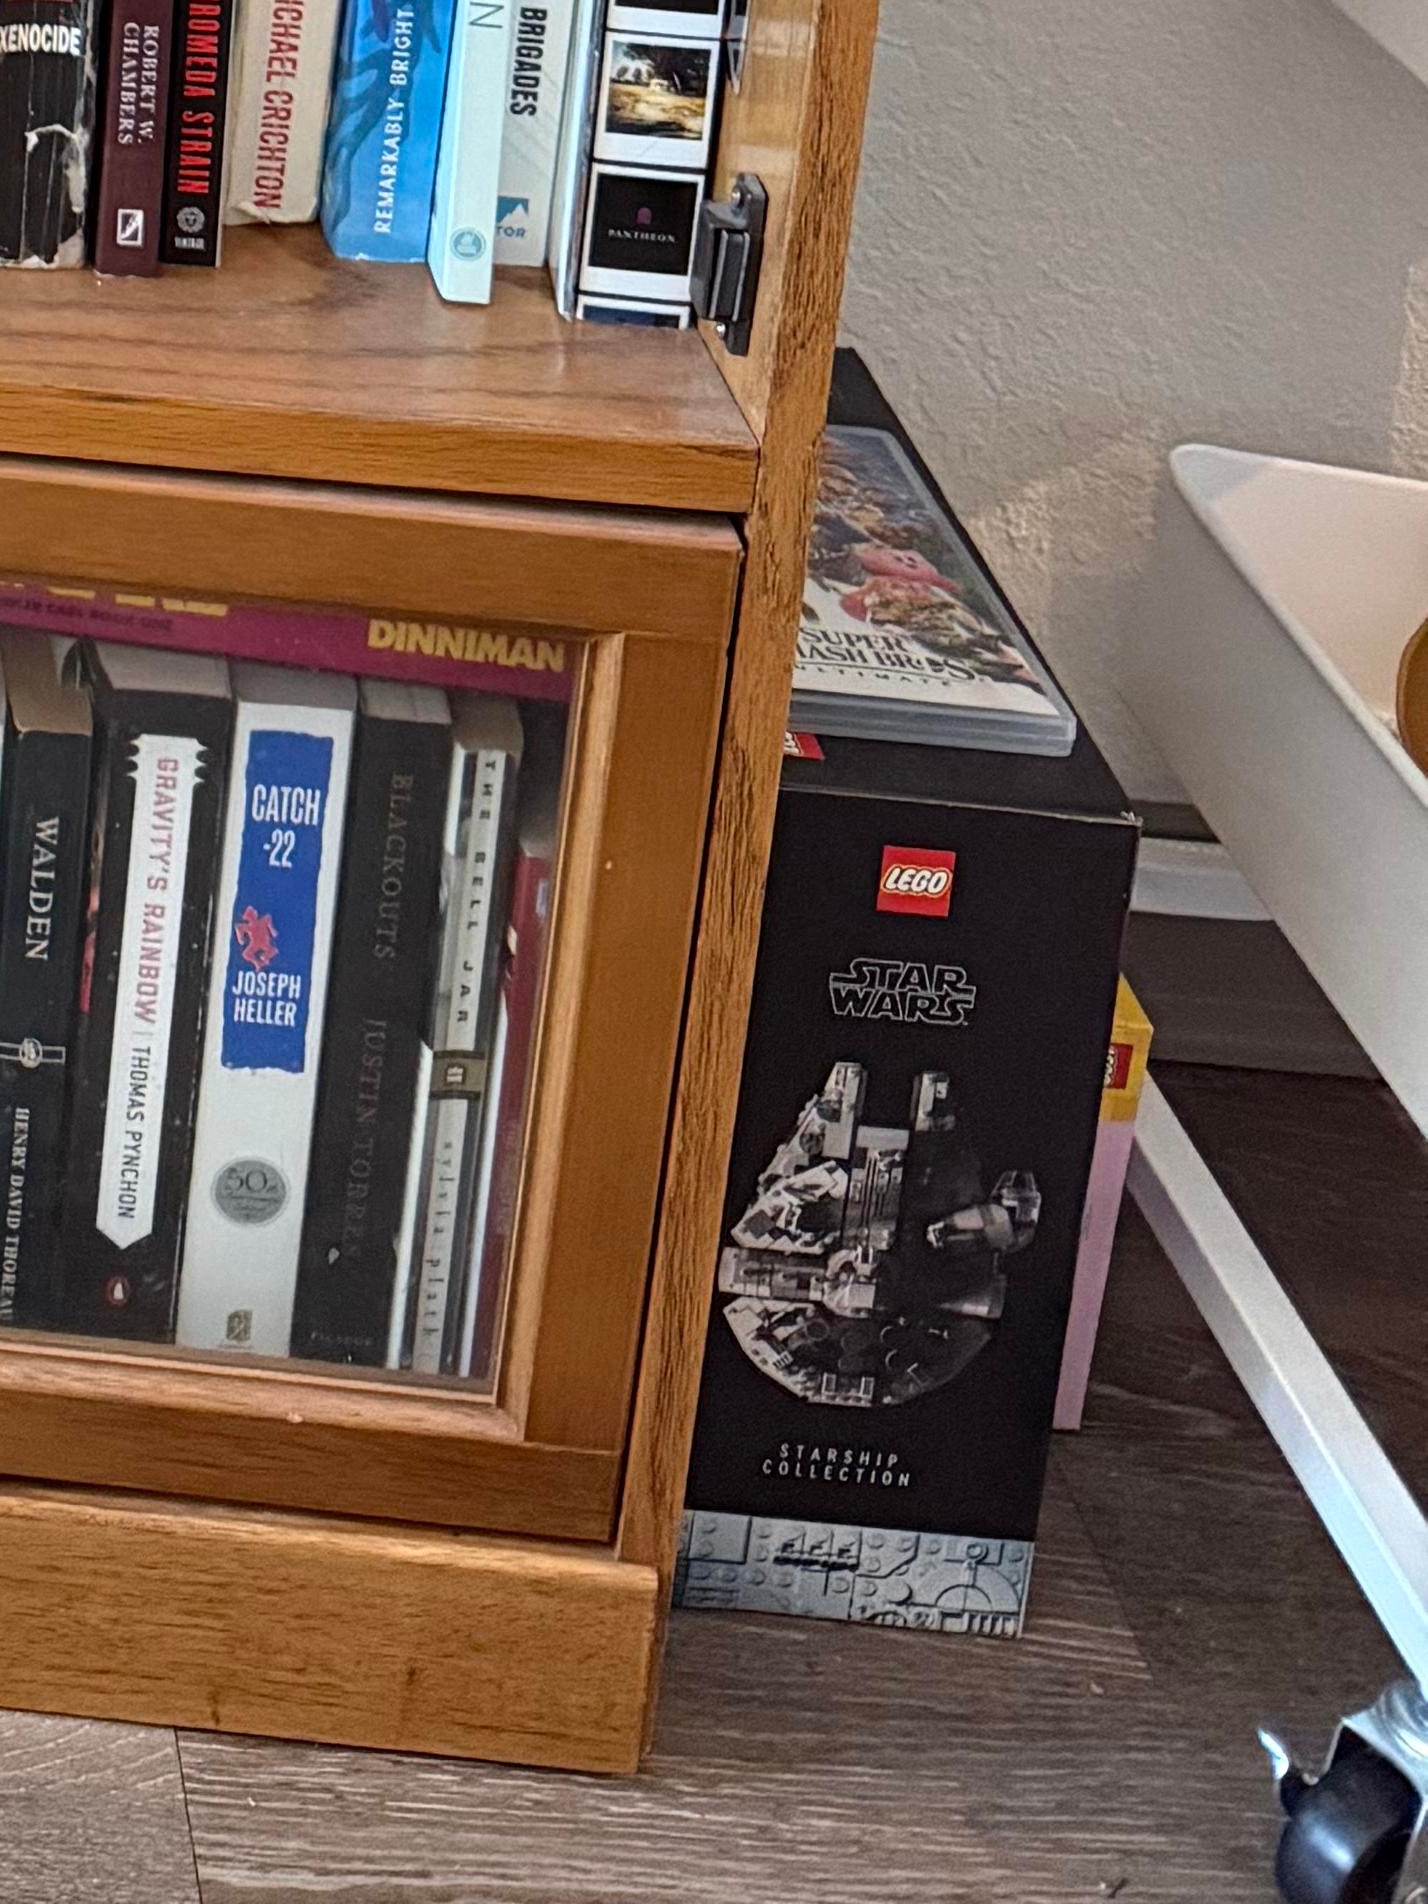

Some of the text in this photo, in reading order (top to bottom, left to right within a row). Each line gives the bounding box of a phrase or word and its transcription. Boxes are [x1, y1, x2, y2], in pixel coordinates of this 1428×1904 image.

[367, 621, 567, 672] DINNIMAN
[251, 785, 320, 823] CATCH
[881, 865, 950, 895] LEGO
[233, 970, 301, 997] JOSEPH
[830, 958, 976, 993] STAR
[233, 998, 297, 1026] HELLER
[830, 989, 974, 1024] WARS
[779, 1444, 899, 1470] STARSHIP
[762, 1459, 911, 1487] COLLECTION
